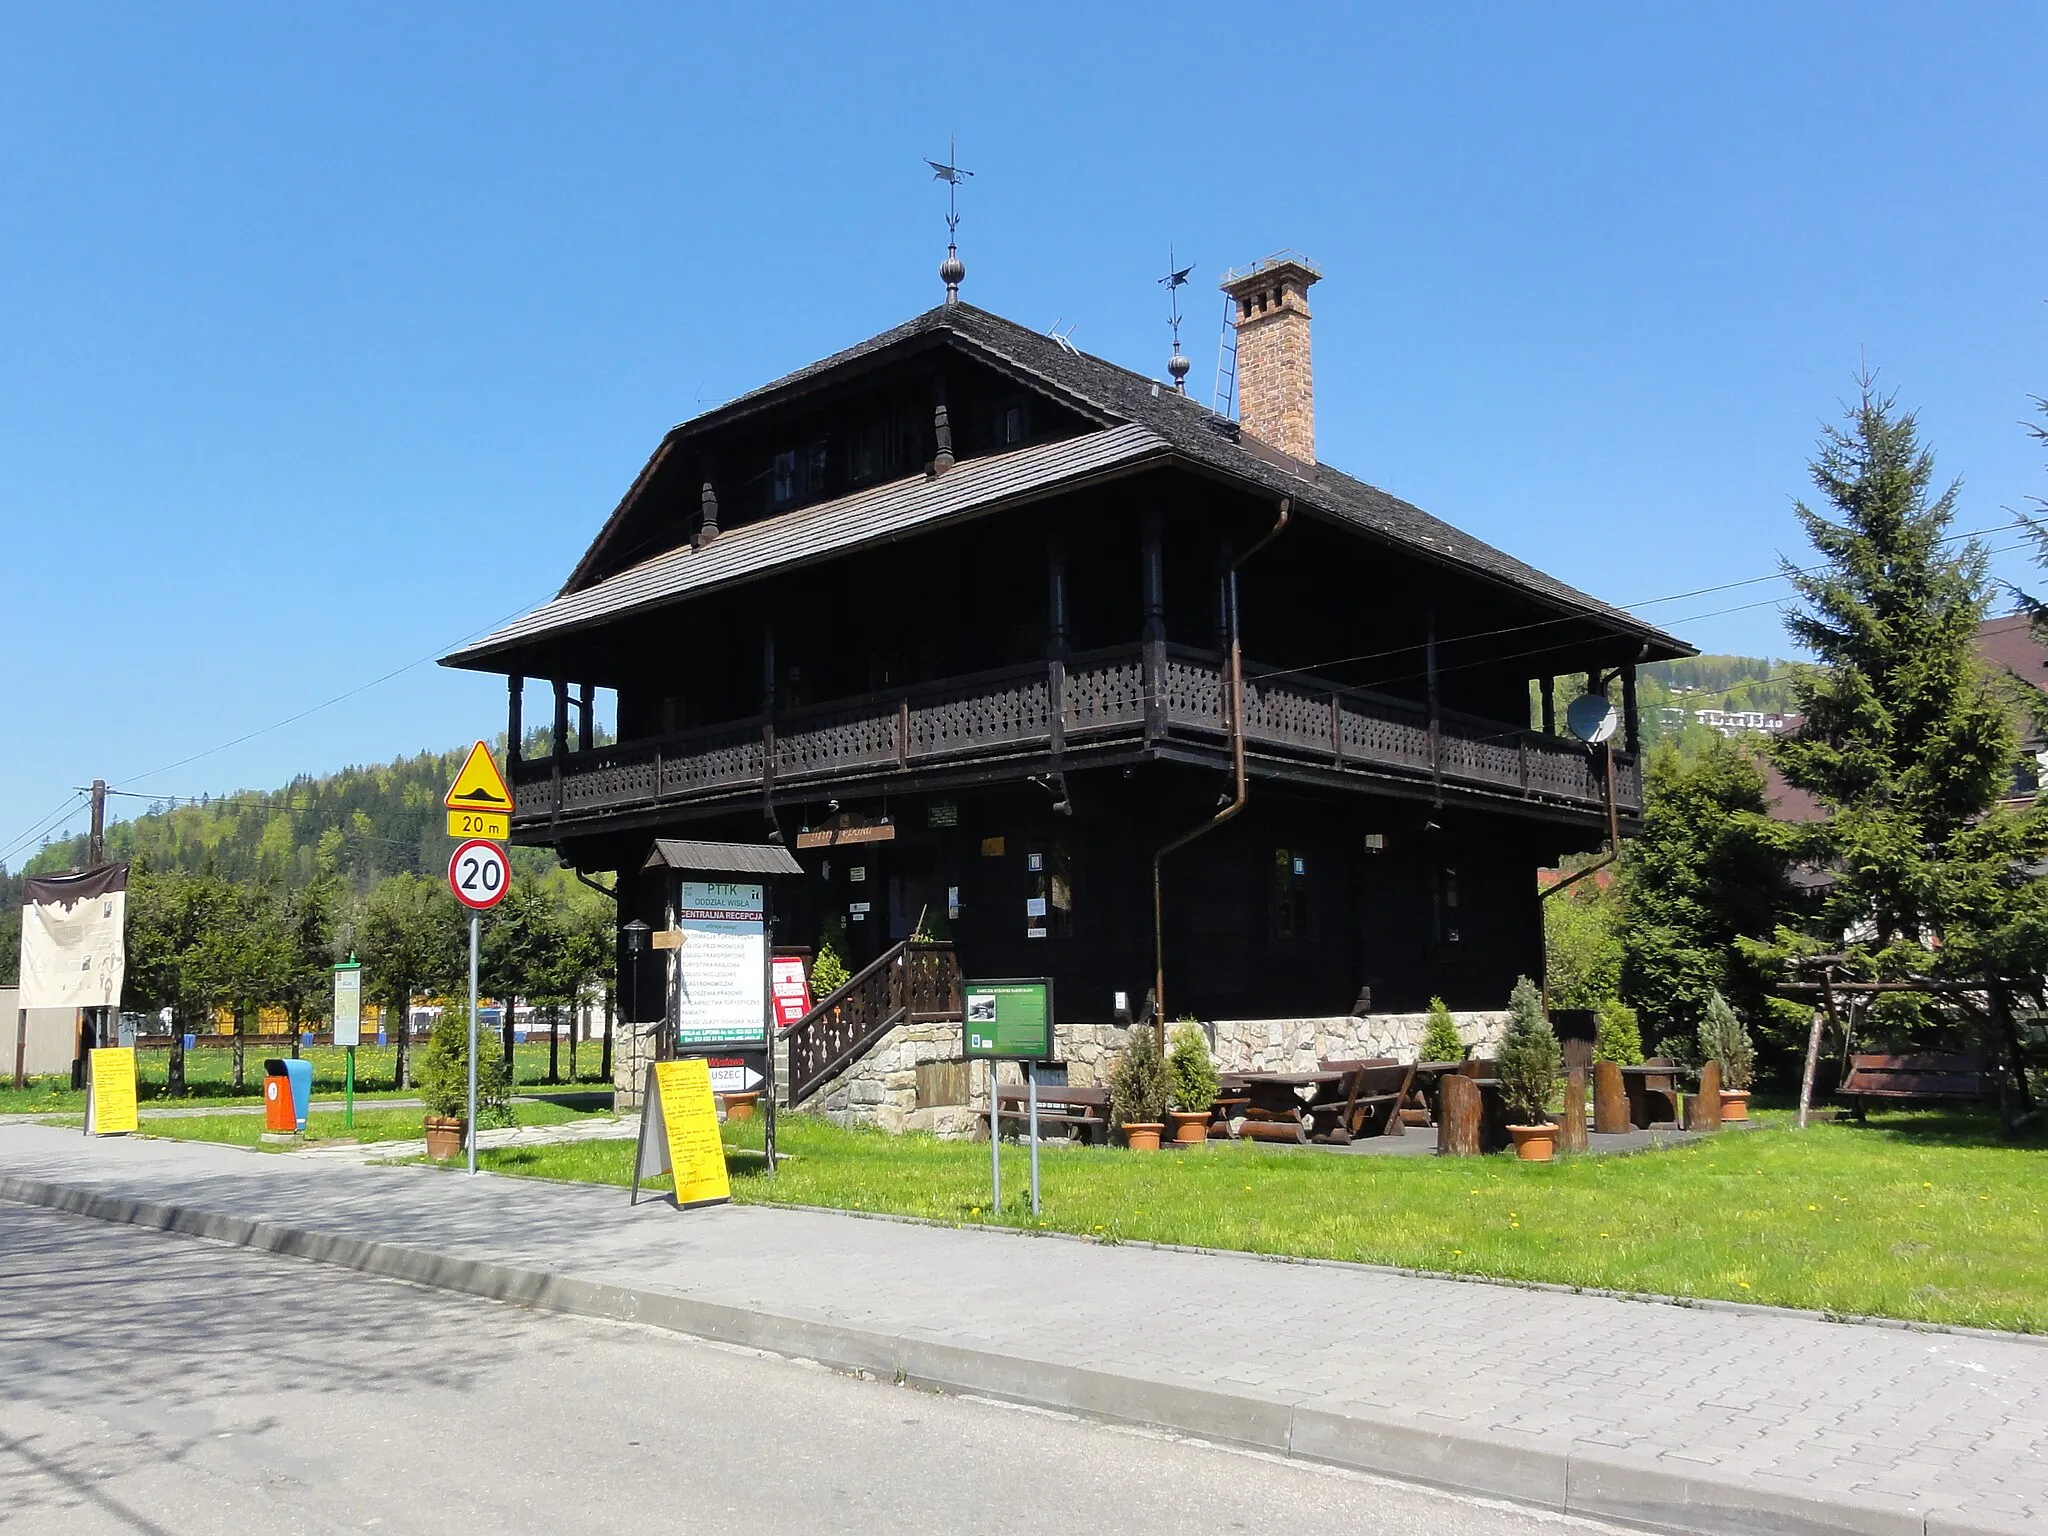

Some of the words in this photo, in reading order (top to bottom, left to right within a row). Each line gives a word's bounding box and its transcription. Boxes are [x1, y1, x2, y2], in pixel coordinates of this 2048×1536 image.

[462, 816, 483, 832] 20
[489, 825, 499, 834] m
[461, 857, 501, 891] 20
[707, 883, 737, 896] PTTK
[694, 898, 725, 906] ODDZIAŁ
[727, 899, 750, 908] WISŁA
[681, 910, 724, 919] CENTRALNA
[725, 912, 763, 920] RECEPCJA
